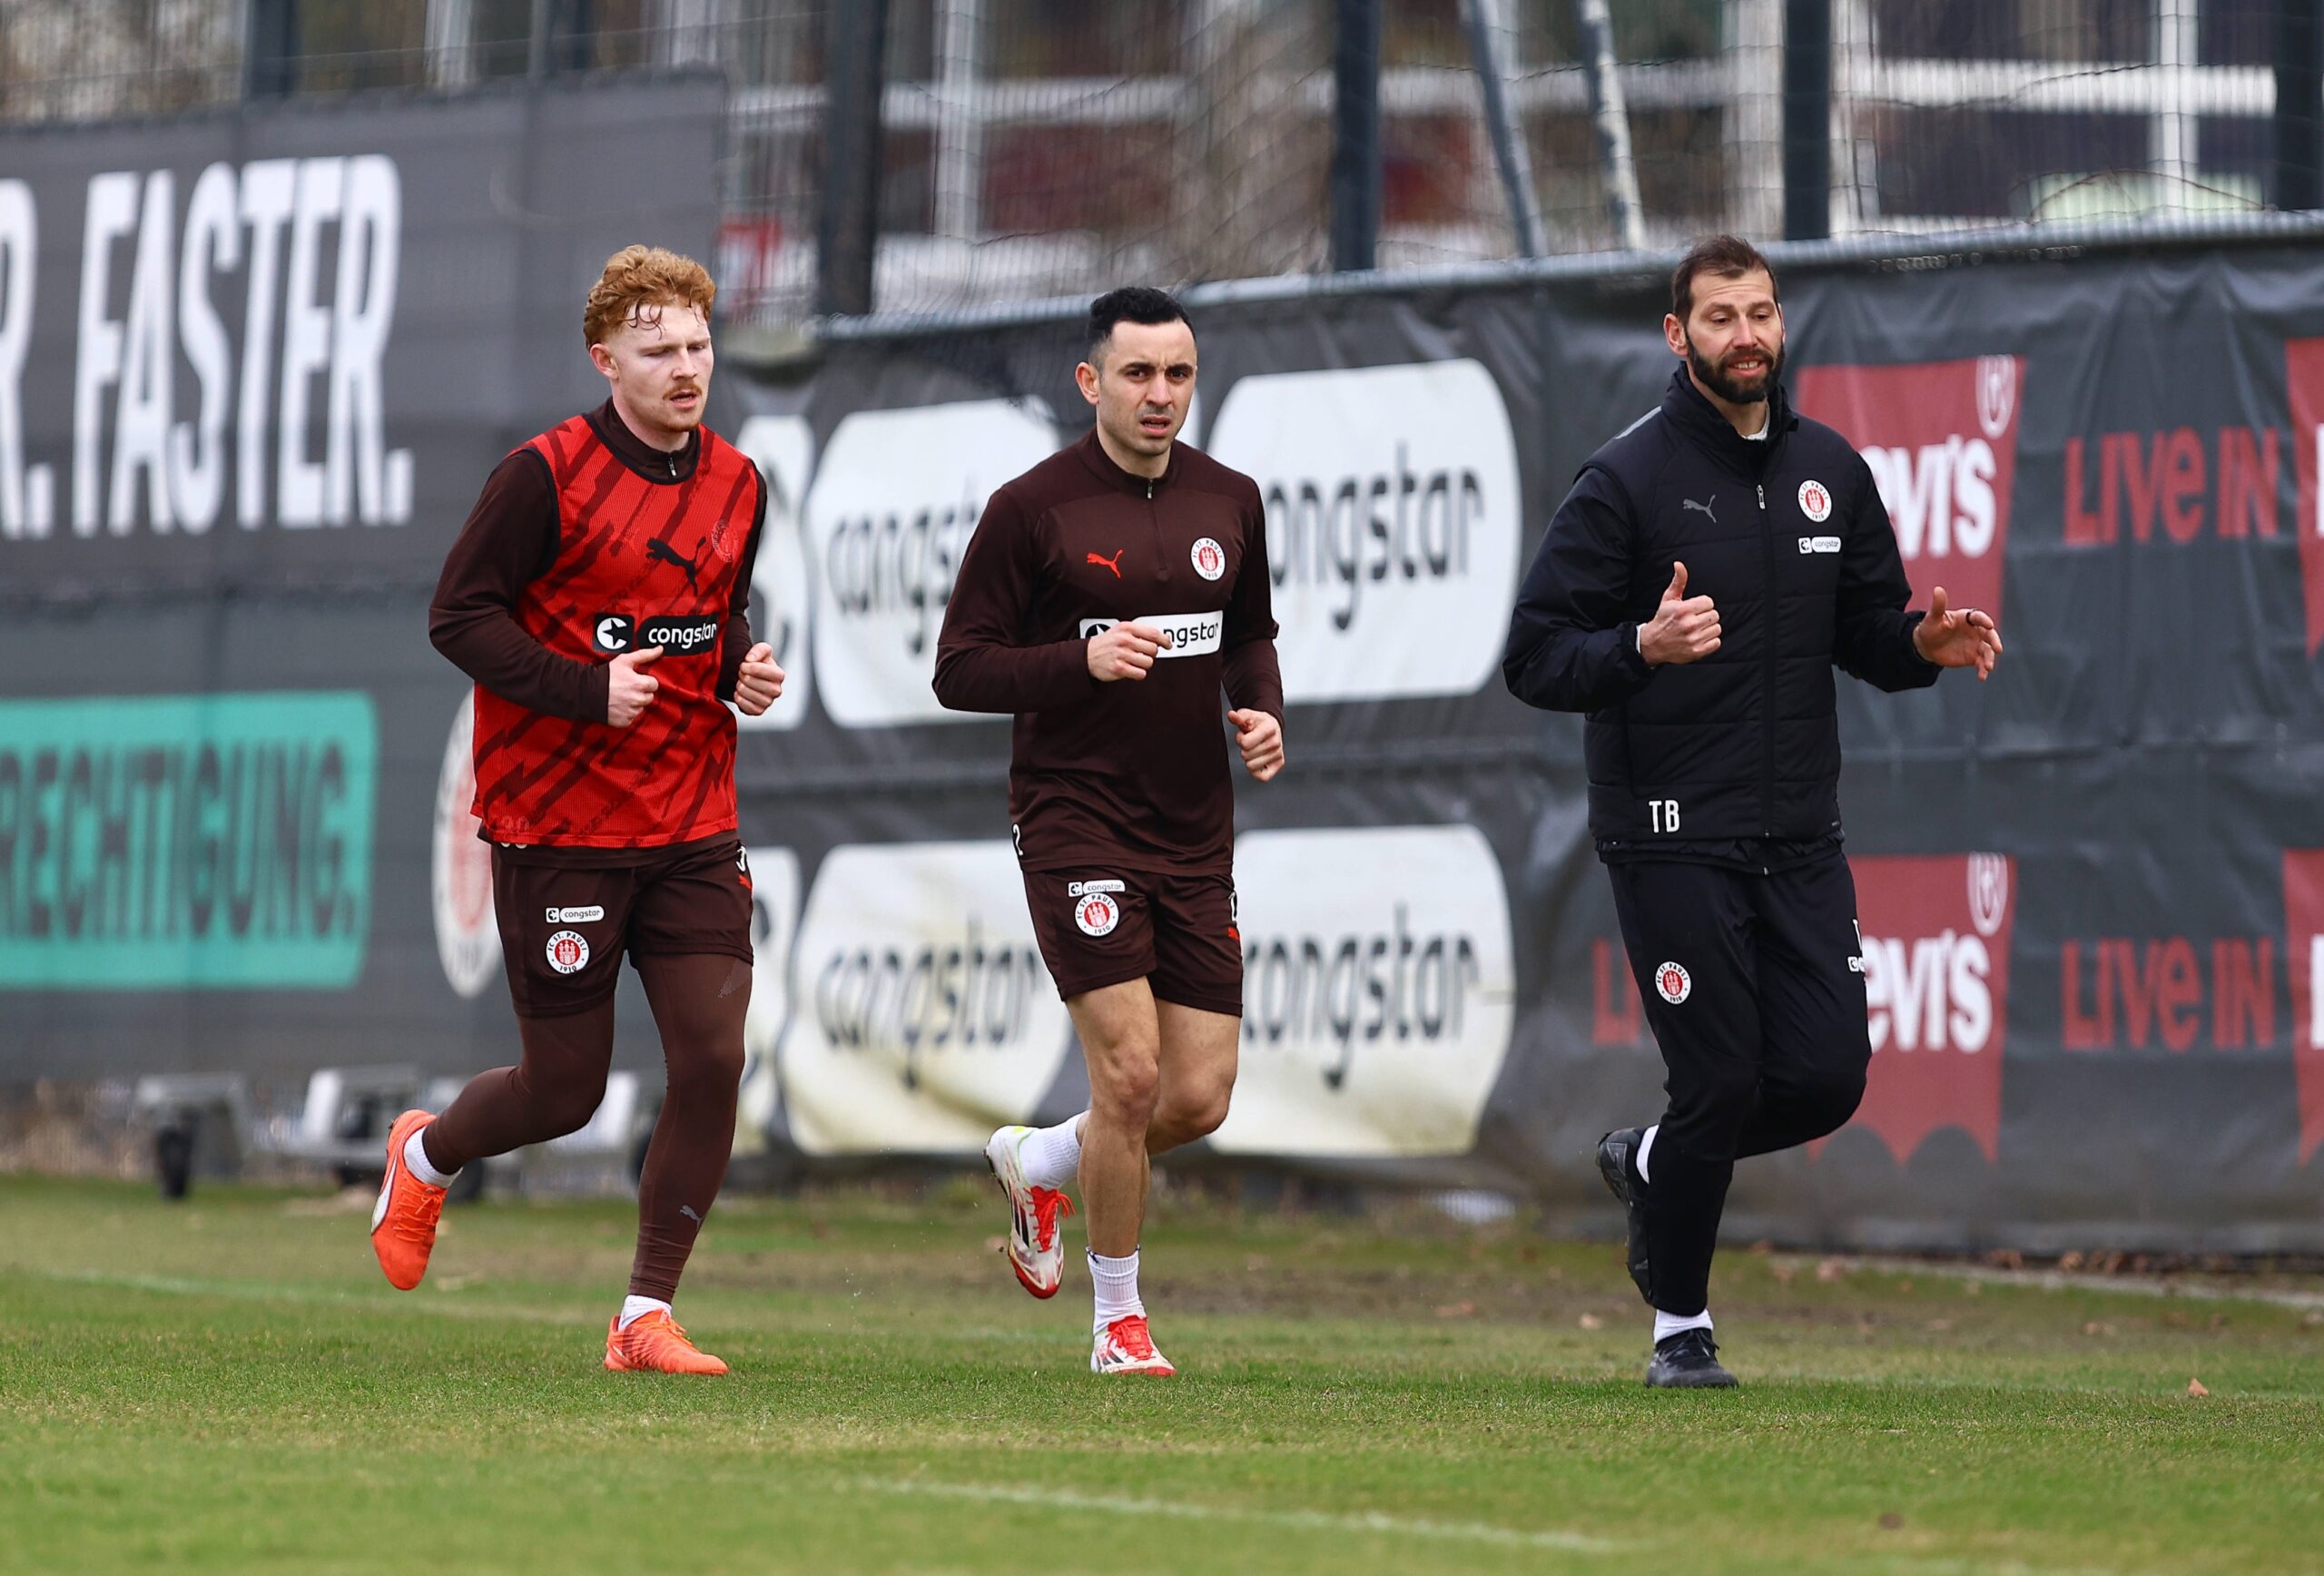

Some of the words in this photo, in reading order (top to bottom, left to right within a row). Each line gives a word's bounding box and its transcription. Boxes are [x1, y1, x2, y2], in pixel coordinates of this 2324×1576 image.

[72, 153, 414, 539] FASTER.
[2218, 425, 2278, 539] IN
[1265, 441, 1485, 631] ongstar
[648, 623, 717, 649] congstar
[1163, 622, 1219, 648] ngstar
[1648, 800, 1680, 833] TB
[564, 910, 600, 919] congstar
[1091, 894, 1116, 909] PAULI
[566, 931, 587, 951] PAULI
[1095, 925, 1110, 934] 1910
[559, 965, 577, 973] 1910
[1669, 962, 1689, 981] PAULI
[815, 911, 1046, 1094] congstar
[2212, 936, 2275, 1049] IN
